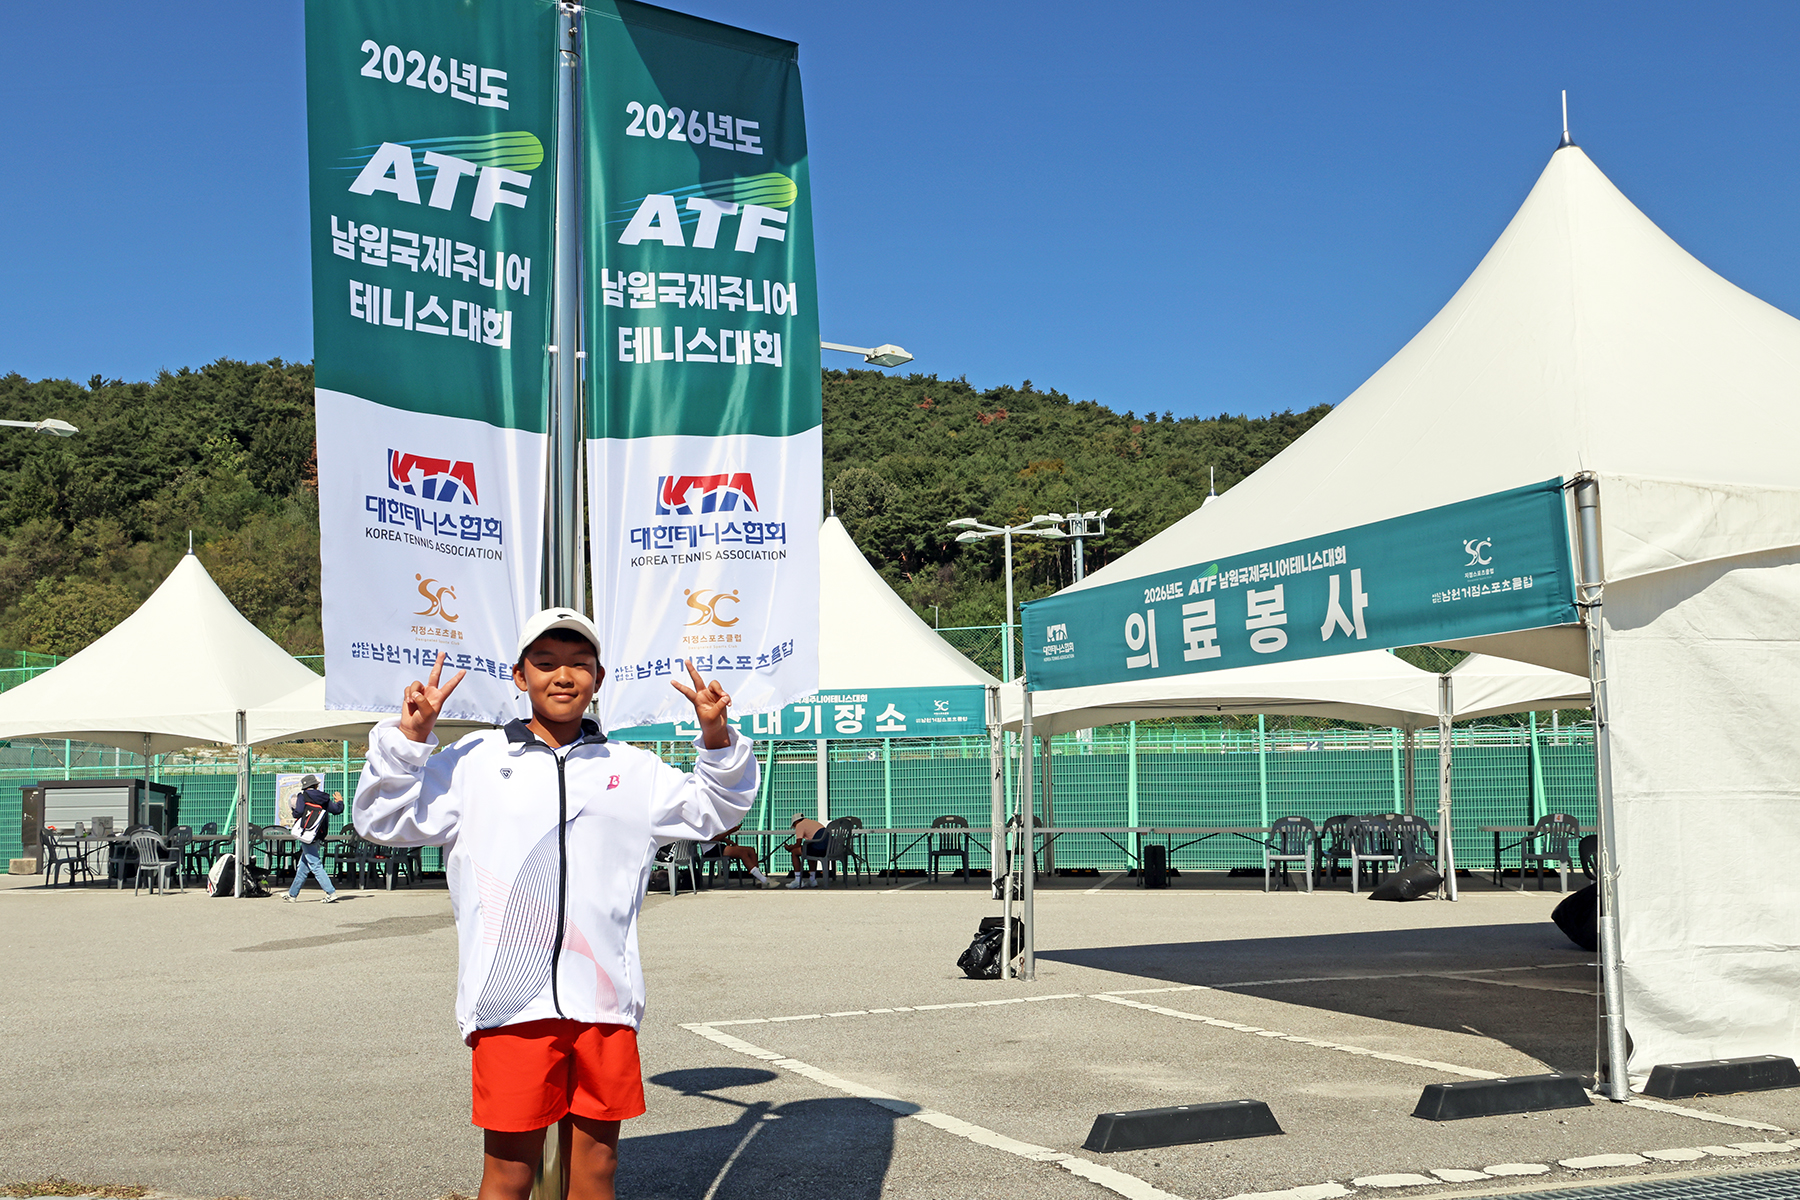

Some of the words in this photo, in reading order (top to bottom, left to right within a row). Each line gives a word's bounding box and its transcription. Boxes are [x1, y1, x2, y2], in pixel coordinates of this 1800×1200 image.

[360, 39, 510, 111] 2026년도
[625, 101, 764, 156] 2026년도
[348, 141, 533, 222] ATF
[617, 193, 789, 254] ATF
[330, 215, 532, 296] 남원국제주니어
[348, 279, 513, 350] 테니스대회
[600, 268, 798, 316] 남원국제주니어
[618, 326, 784, 368] 테니스대회
[387, 447, 479, 506] KTA
[655, 472, 759, 516] KTA
[365, 495, 503, 545] 대한테니스협회
[365, 527, 402, 542] KOREA
[403, 532, 435, 550] TENNIS
[435, 542, 503, 561] ASSOCIATION
[630, 520, 787, 551] 대한테니스협회
[630, 555, 669, 568] KOREA
[671, 550, 713, 564] TENNIS
[714, 549, 788, 561] ASSOCIATION
[1144, 581, 1184, 604] 2026년도
[1188, 575, 1217, 596] ATF
[1219, 545, 1347, 590] 남원국제주니어테니스대회
[410, 625, 464, 640] 지정스포츠클럽
[682, 633, 742, 644] 지정스포츠클럽
[1047, 623, 1068, 642] KTA
